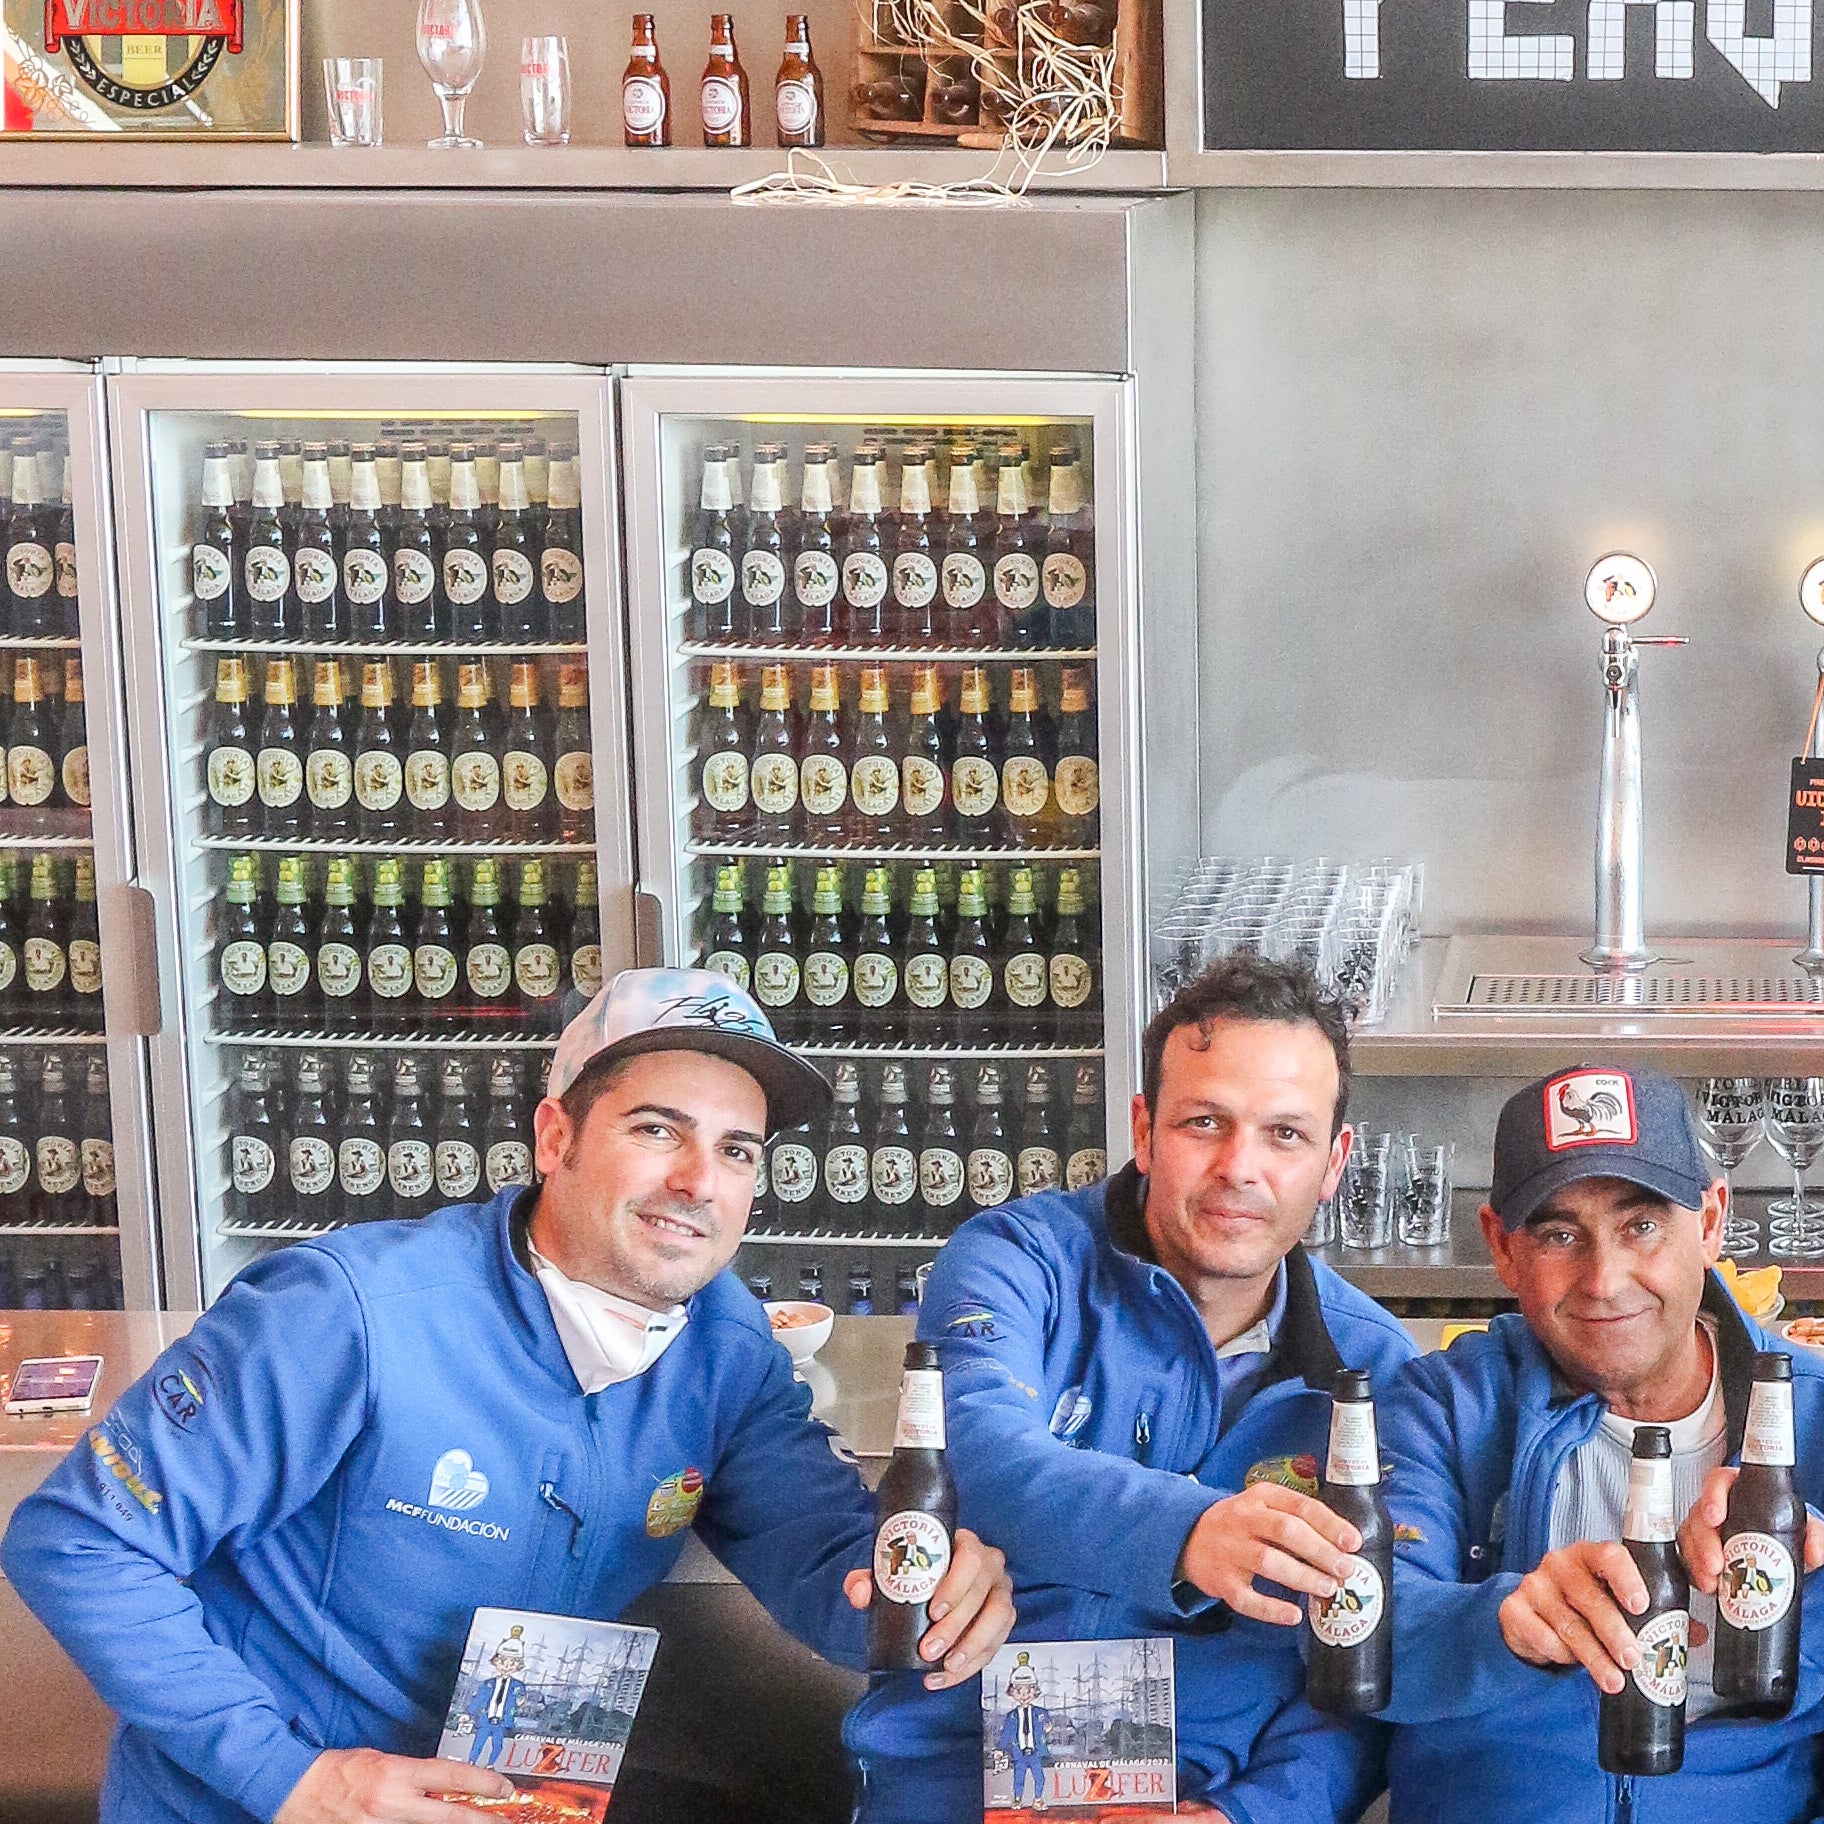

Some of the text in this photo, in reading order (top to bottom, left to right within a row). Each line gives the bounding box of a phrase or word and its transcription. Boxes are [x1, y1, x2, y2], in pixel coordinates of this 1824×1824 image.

[127, 45, 163, 55] BEER
[96, 79, 195, 107] ESPECIAL
[160, 1374, 197, 1424] CAR
[883, 1520, 941, 1546] VICTORIA
[1725, 1542, 1782, 1568] VICTORIA
[886, 1575, 936, 1595] MÁLAGA
[1726, 1600, 1778, 1620] MÁLAGA
[1318, 1617, 1370, 1637] MÁLAGA
[515, 1734, 554, 1745] CARNAVAL
[1054, 1757, 1169, 1769] CARNAVAL DE MÁLAGA 2022
